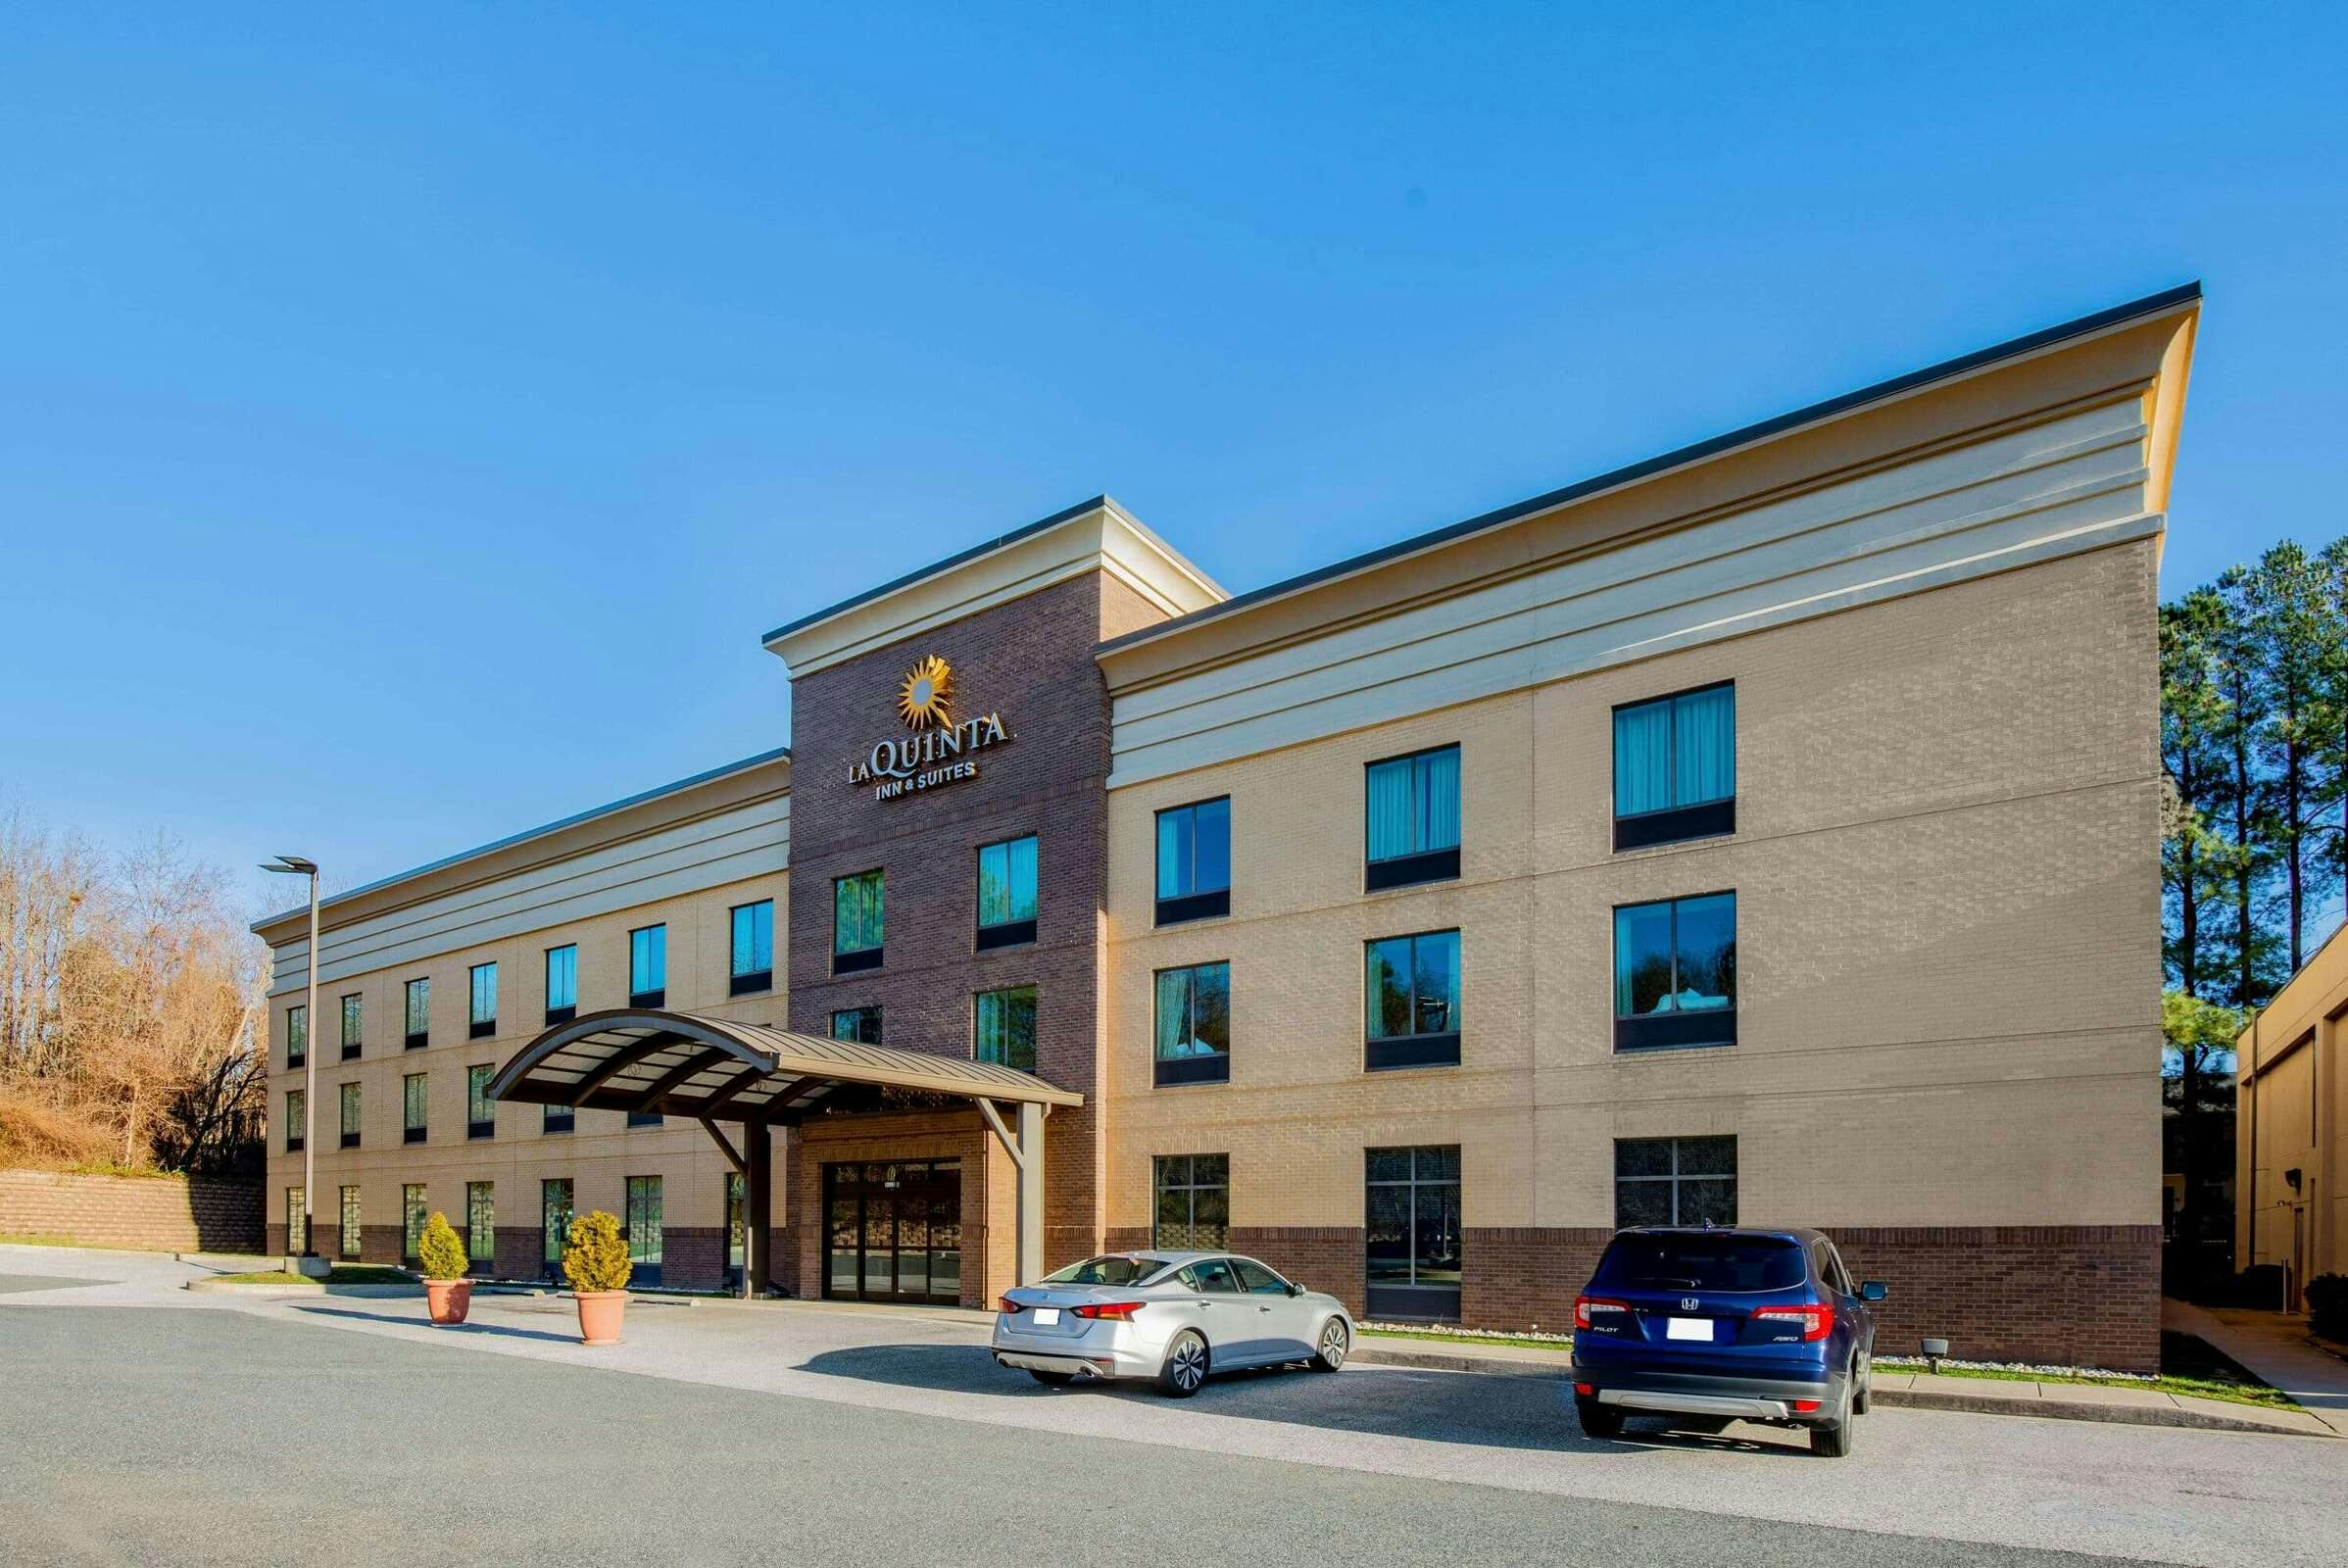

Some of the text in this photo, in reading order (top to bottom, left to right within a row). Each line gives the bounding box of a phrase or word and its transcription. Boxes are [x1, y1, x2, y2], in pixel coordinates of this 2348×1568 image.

[849, 712, 1008, 782] LA QUINTA
[876, 761, 977, 800] INN & SUITES
